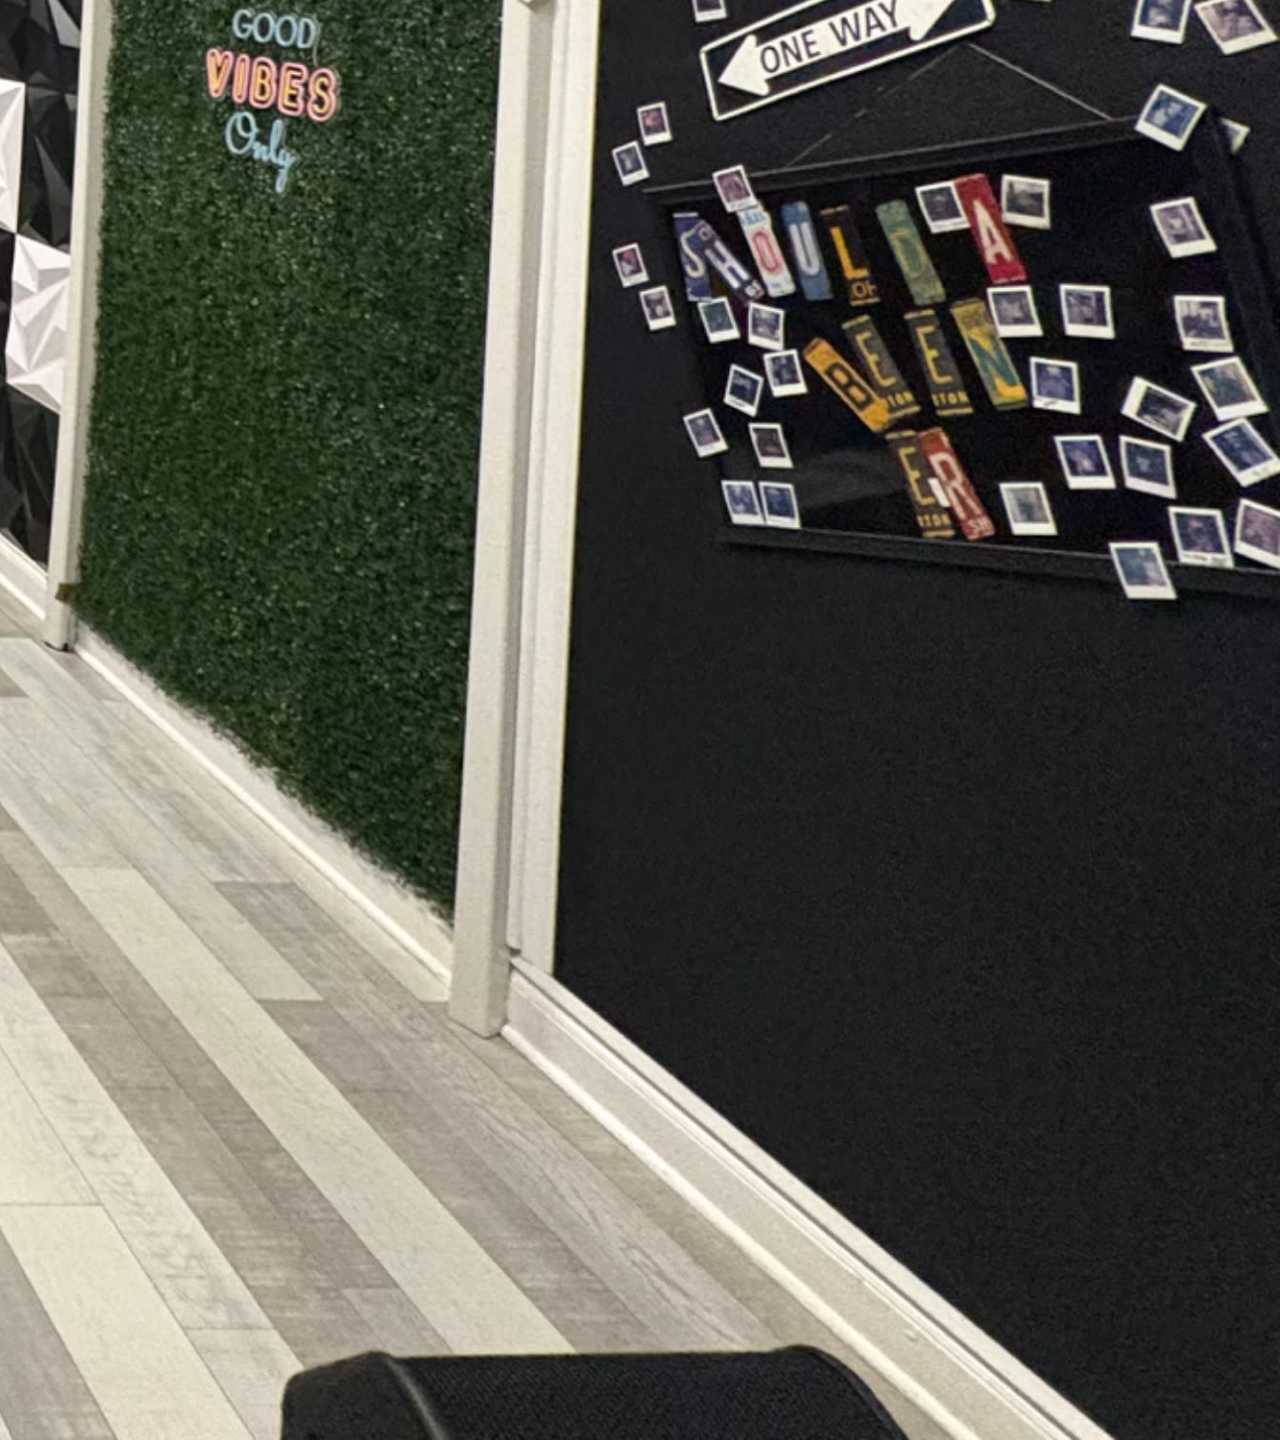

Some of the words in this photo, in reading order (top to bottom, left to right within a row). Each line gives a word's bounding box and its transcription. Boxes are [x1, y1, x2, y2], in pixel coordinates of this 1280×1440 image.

[232, 9, 316, 48] GOOD
[760, 29, 821, 73] ONE
[206, 48, 337, 120] VIBES
[225, 111, 297, 192] Only
